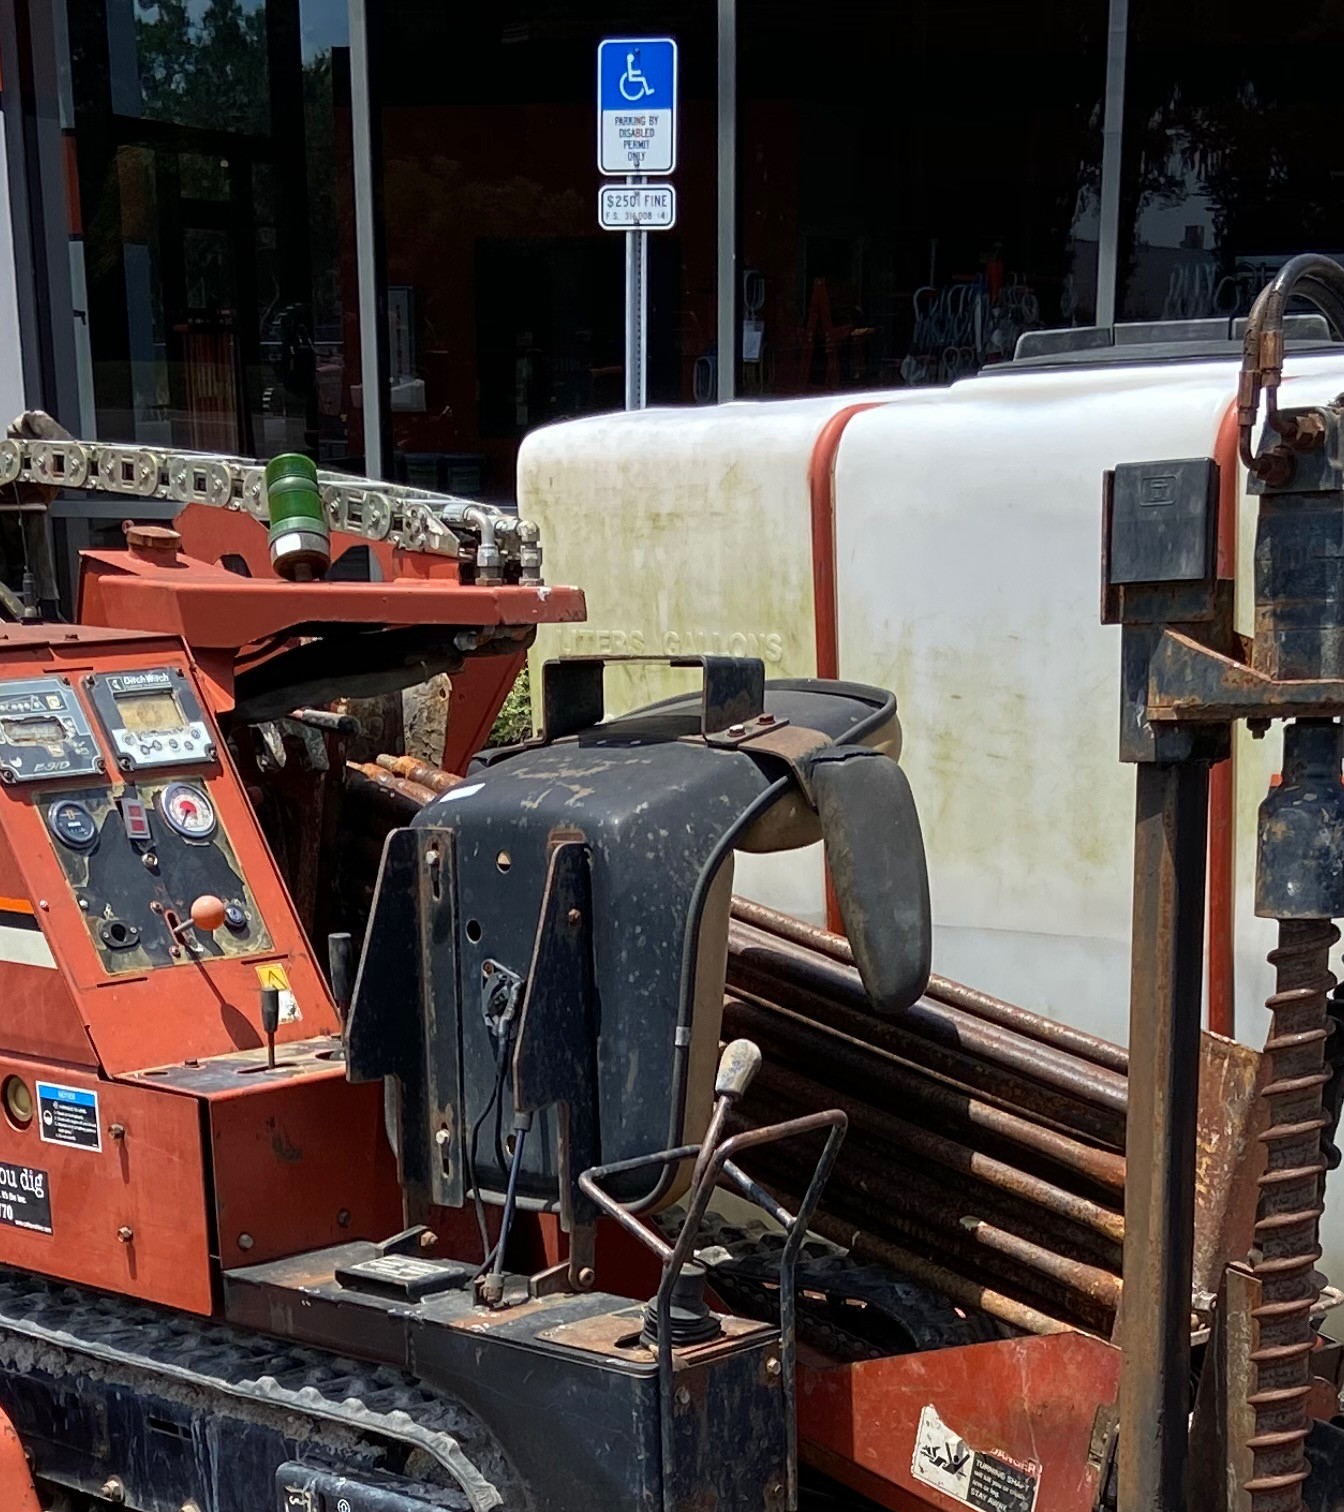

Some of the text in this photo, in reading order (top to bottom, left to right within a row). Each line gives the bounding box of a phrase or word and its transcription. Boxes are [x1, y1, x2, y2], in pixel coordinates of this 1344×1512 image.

[614, 115, 659, 126] PARKING BY
[618, 128, 655, 138] DISABLED
[623, 139, 650, 150] PERMIT
[627, 151, 646, 162] ONLY
[644, 194, 668, 208] FINE
[19, 1168, 46, 1199] dig
